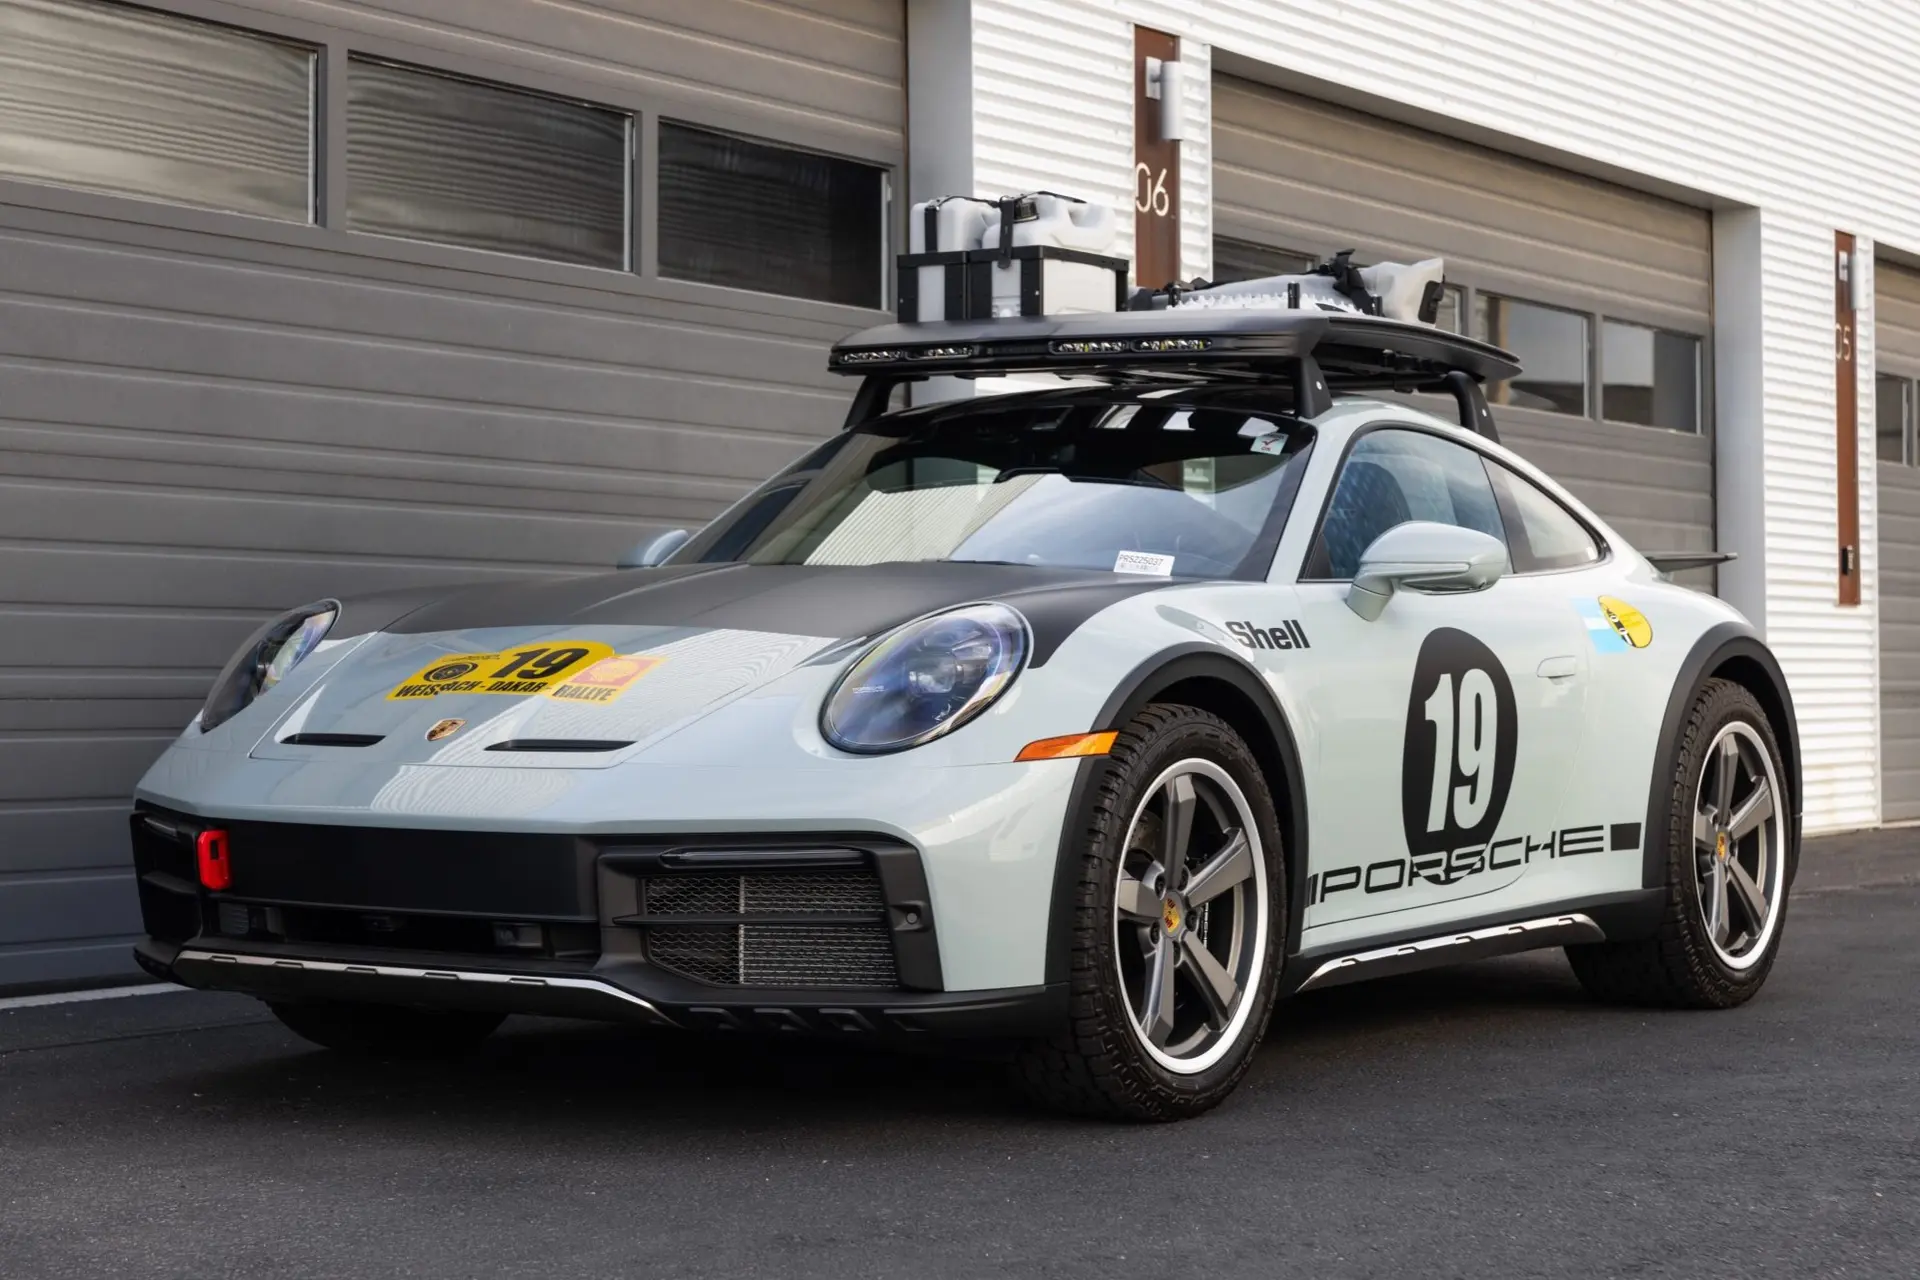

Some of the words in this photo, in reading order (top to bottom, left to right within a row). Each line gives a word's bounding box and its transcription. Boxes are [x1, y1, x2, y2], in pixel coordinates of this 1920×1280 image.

[1135, 162, 1170, 217] 06
[1224, 619, 1312, 650] Shell
[488, 647, 590, 680] 19
[485, 681, 548, 693] DAKAR
[552, 684, 617, 701] RALLYE
[1424, 668, 1498, 833] 19
[1319, 825, 1604, 903] PORSCHE
